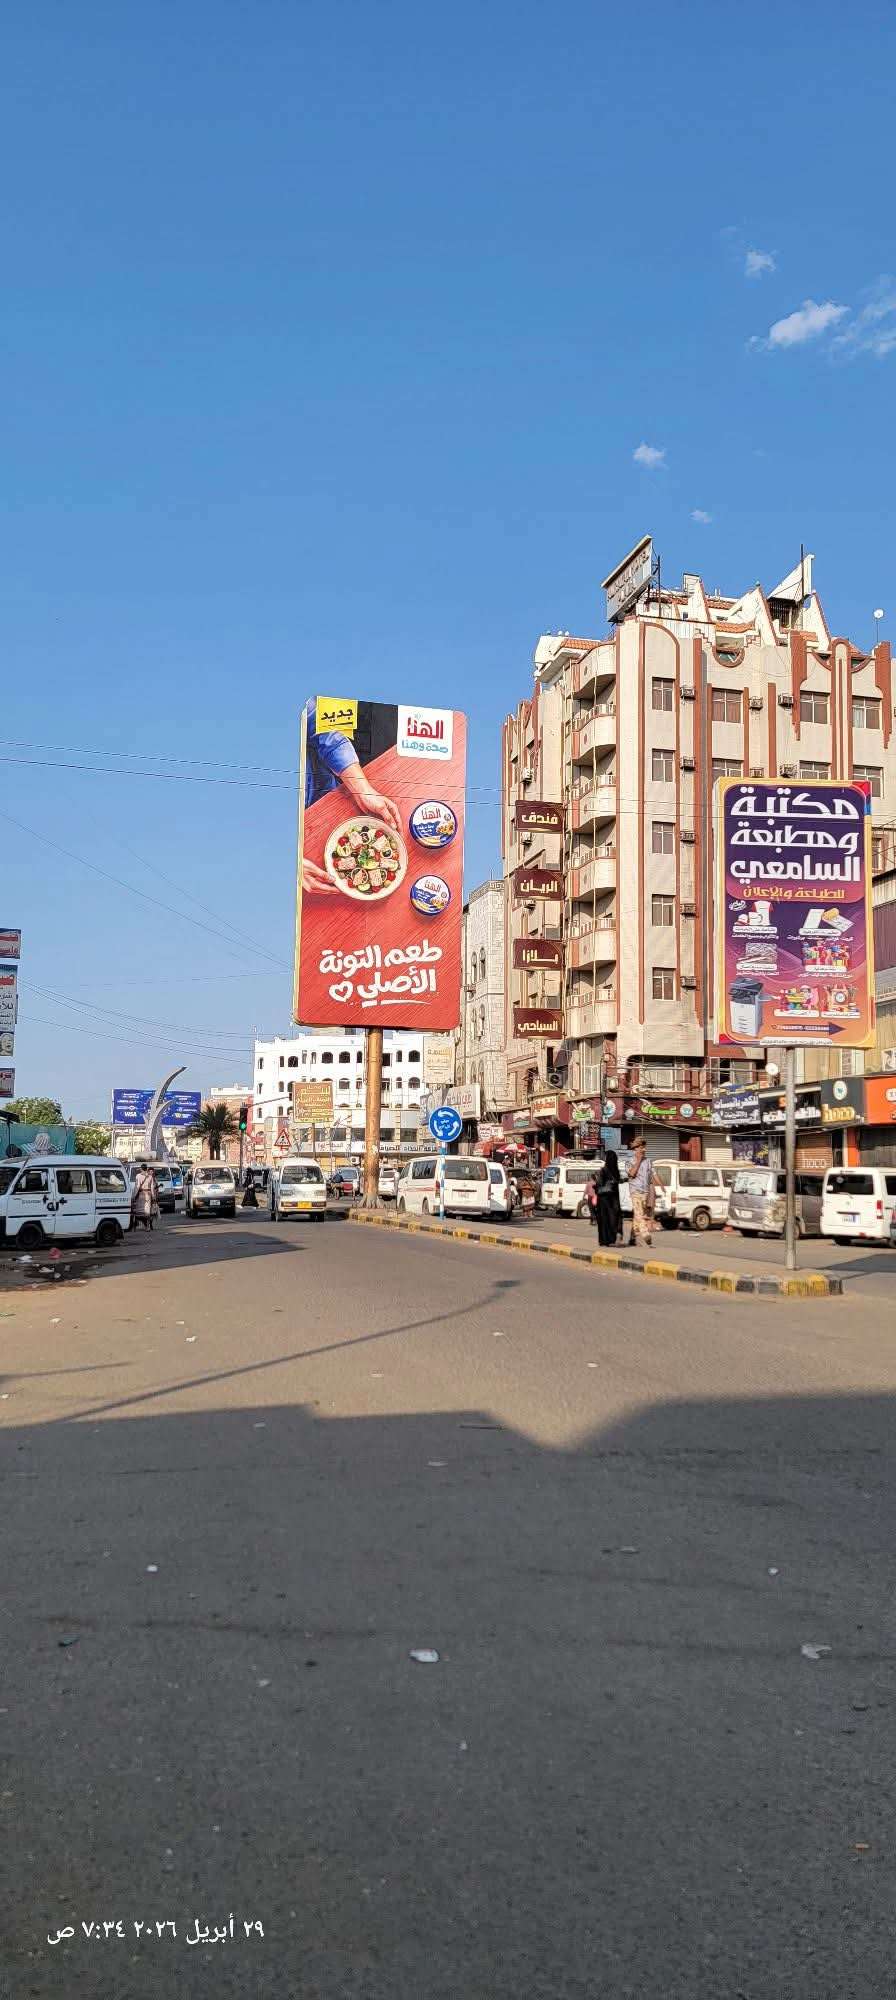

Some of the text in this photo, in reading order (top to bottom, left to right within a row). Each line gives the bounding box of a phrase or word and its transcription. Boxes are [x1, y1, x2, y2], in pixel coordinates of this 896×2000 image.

[321, 707, 353, 722] جديد
[402, 739, 449, 754] صحة وهنا
[730, 786, 860, 826] مكتبة
[521, 812, 559, 826] فندق
[730, 821, 860, 855] ومطبعة
[730, 855, 861, 884] السامعي
[520, 879, 558, 893] الريان
[794, 887, 845, 901] للطباعة
[319, 938, 443, 978] طعم التونة
[522, 949, 559, 963] بلازا
[356, 965, 437, 1008] الأصلي
[517, 1018, 559, 1032] السياحي
